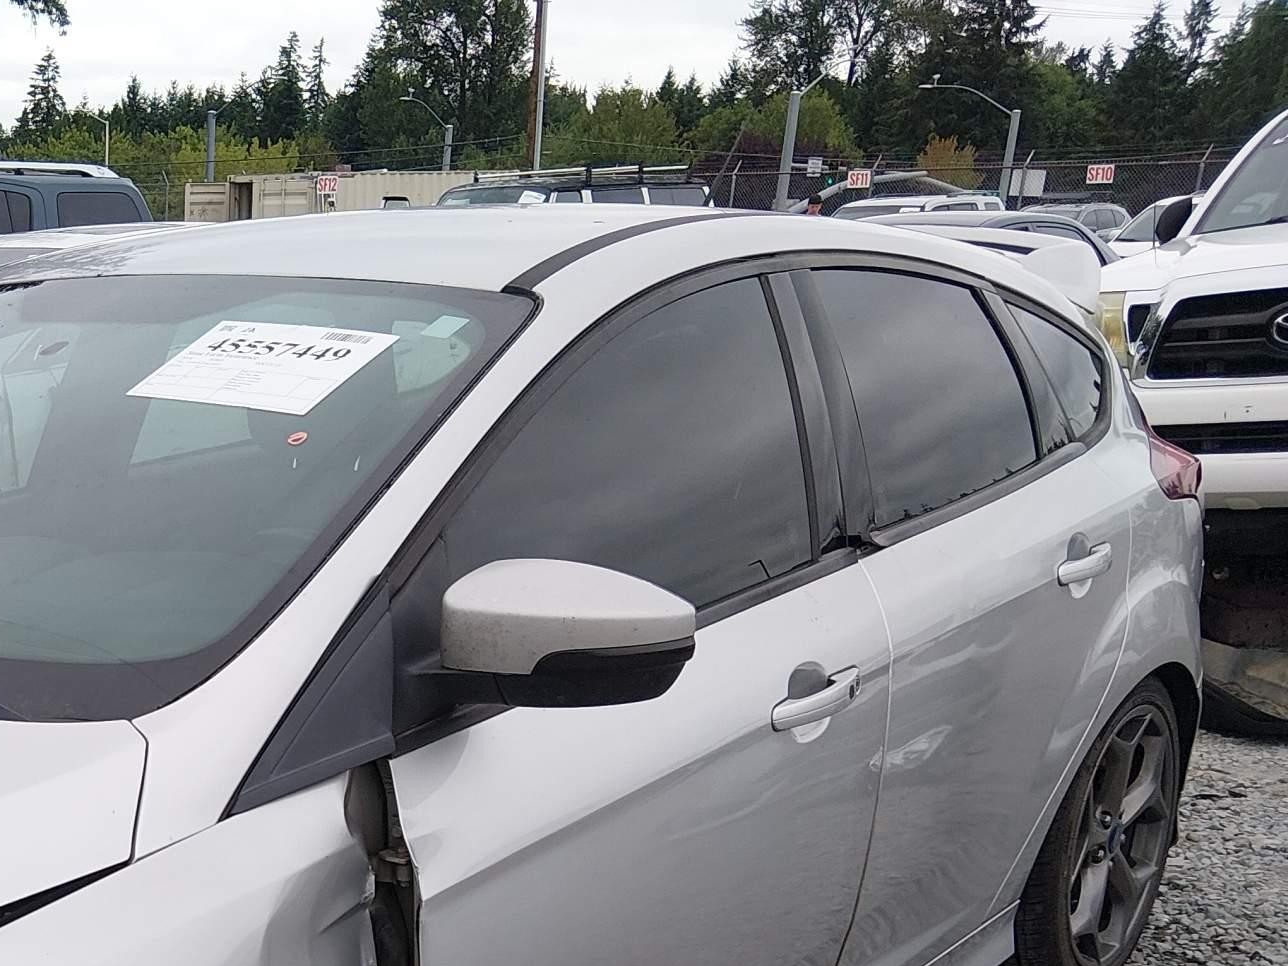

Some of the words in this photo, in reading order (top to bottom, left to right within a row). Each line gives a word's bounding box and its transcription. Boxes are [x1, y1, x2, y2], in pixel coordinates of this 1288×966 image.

[849, 172, 869, 187] SF11
[1088, 166, 1113, 182] SF10
[318, 177, 337, 193] SF12
[207, 338, 352, 361] 45557449
